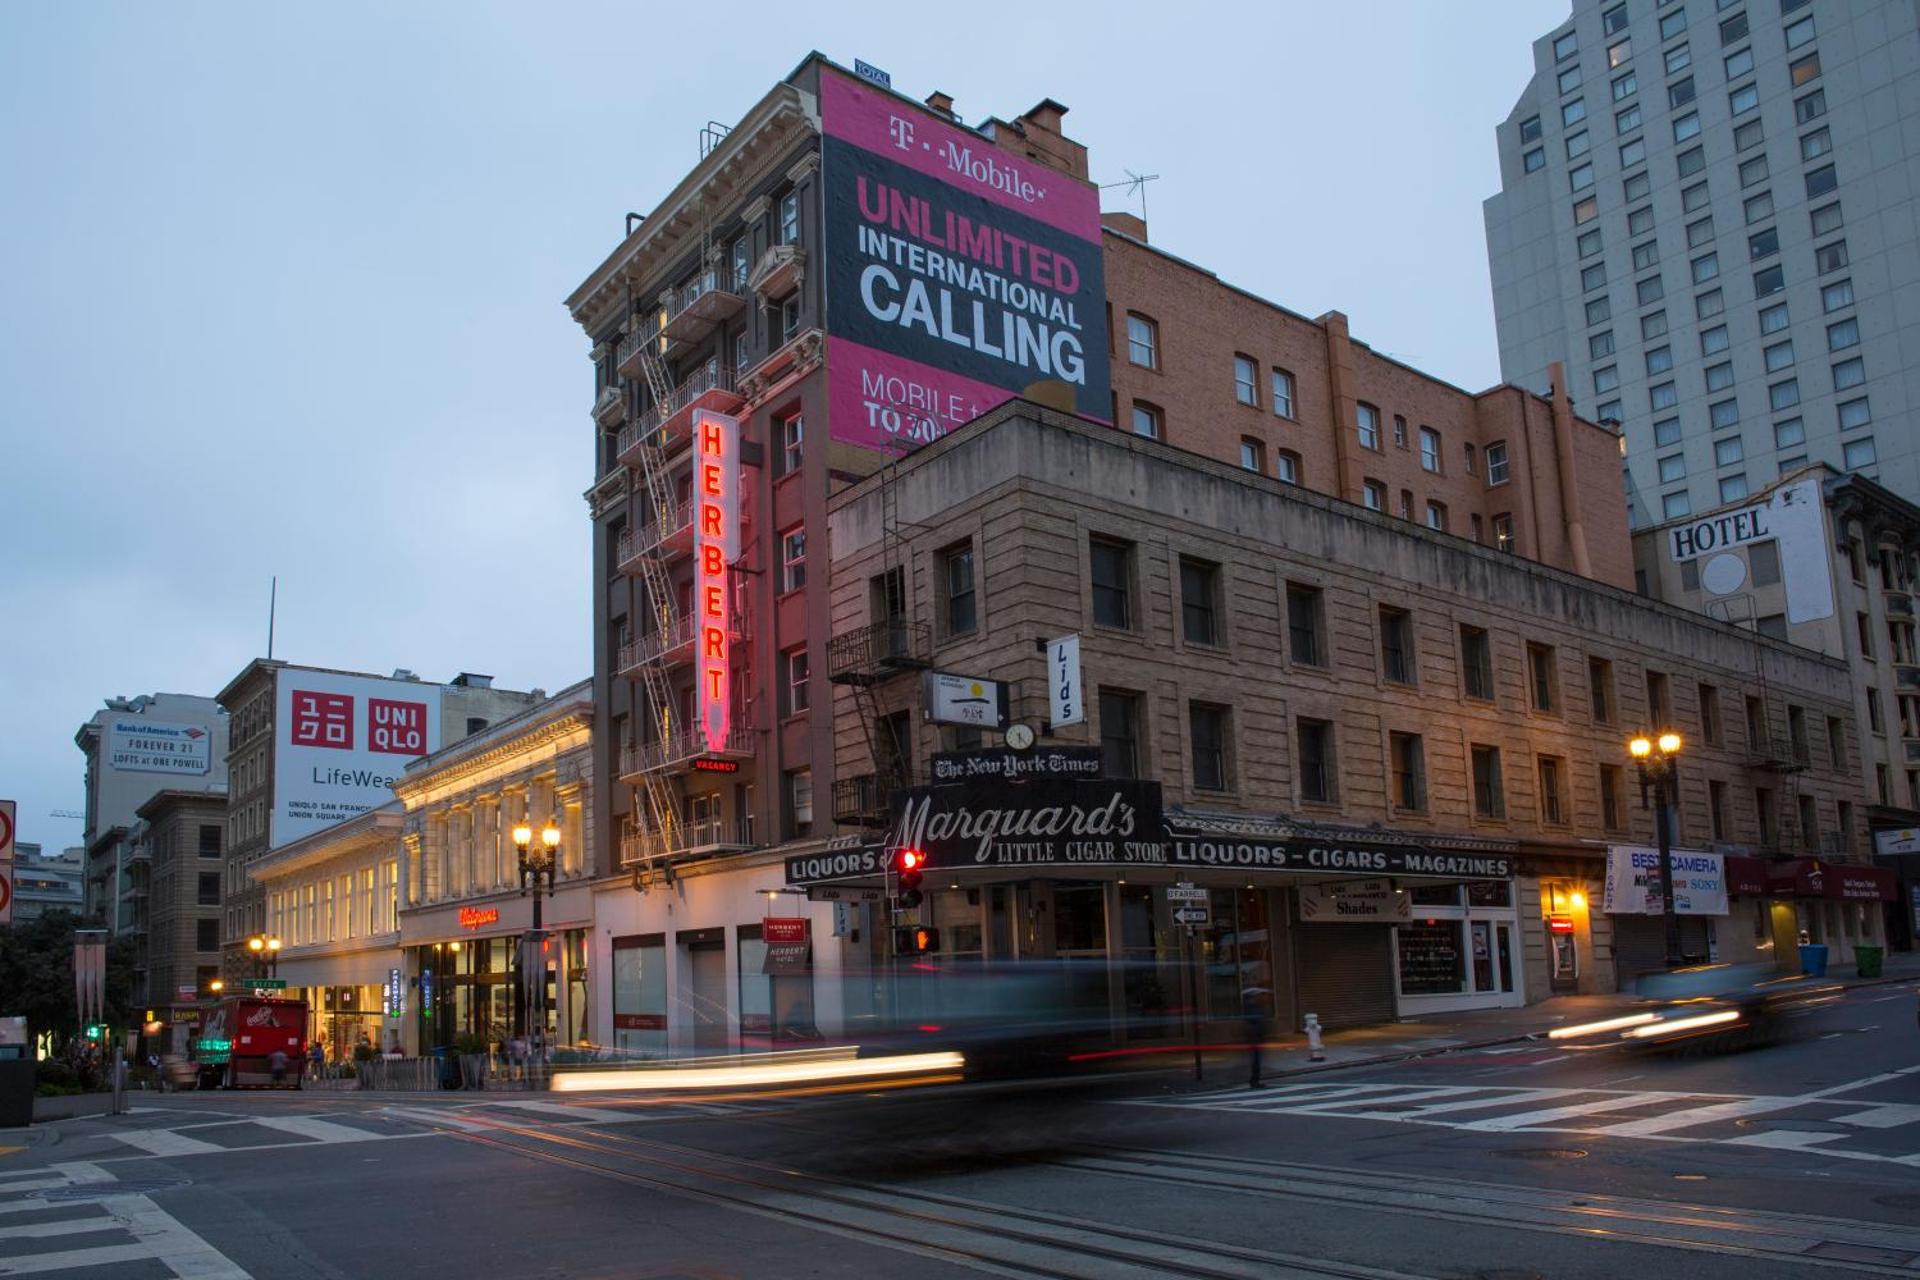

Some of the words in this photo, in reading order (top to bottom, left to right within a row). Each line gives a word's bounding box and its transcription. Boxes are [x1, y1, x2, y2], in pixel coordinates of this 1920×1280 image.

[858, 63, 889, 85] TOTAL
[857, 175, 1081, 296] UNLIMITED
[858, 224, 1082, 331] INTERNATIONAL
[860, 264, 1086, 385] CALLING
[862, 368, 965, 423] MOBILE
[863, 401, 901, 433] TO
[1673, 510, 1769, 557] HOTEL
[703, 424, 725, 698] HERBERT
[1058, 644, 1072, 719] Lids
[128, 739, 176, 752] FOREVER
[180, 743, 193, 753] 21
[113, 754, 139, 764] LOFTS
[152, 757, 169, 767] ONE
[172, 759, 205, 769] POWELL
[695, 760, 736, 772] VACANCY
[935, 760, 965, 779] The
[966, 757, 1001, 777] New
[1002, 754, 1047, 777] York
[1049, 754, 1099, 773] Times
[312, 766, 400, 790] LifeWea
[288, 801, 318, 810] UNIQLO
[320, 803, 337, 811] SAN
[288, 811, 313, 820] UNION
[315, 813, 346, 821] SQUARE
[887, 791, 1136, 864] Marquard's
[791, 850, 876, 879] LIQUORS
[997, 842, 1055, 863] LITTLE
[1065, 841, 1116, 861] CIGAR
[1123, 841, 1168, 863] STORE
[1175, 841, 1287, 866] LIQUORS
[1308, 848, 1387, 869] CIGARS
[1405, 854, 1509, 875] MAGAZINES
[1669, 857, 1718, 873] CAMERA
[1690, 879, 1719, 890] SONY
[1335, 901, 1378, 915] Shades
[769, 946, 806, 956] HERBERT
[392, 969, 400, 1009] PHARMACY
